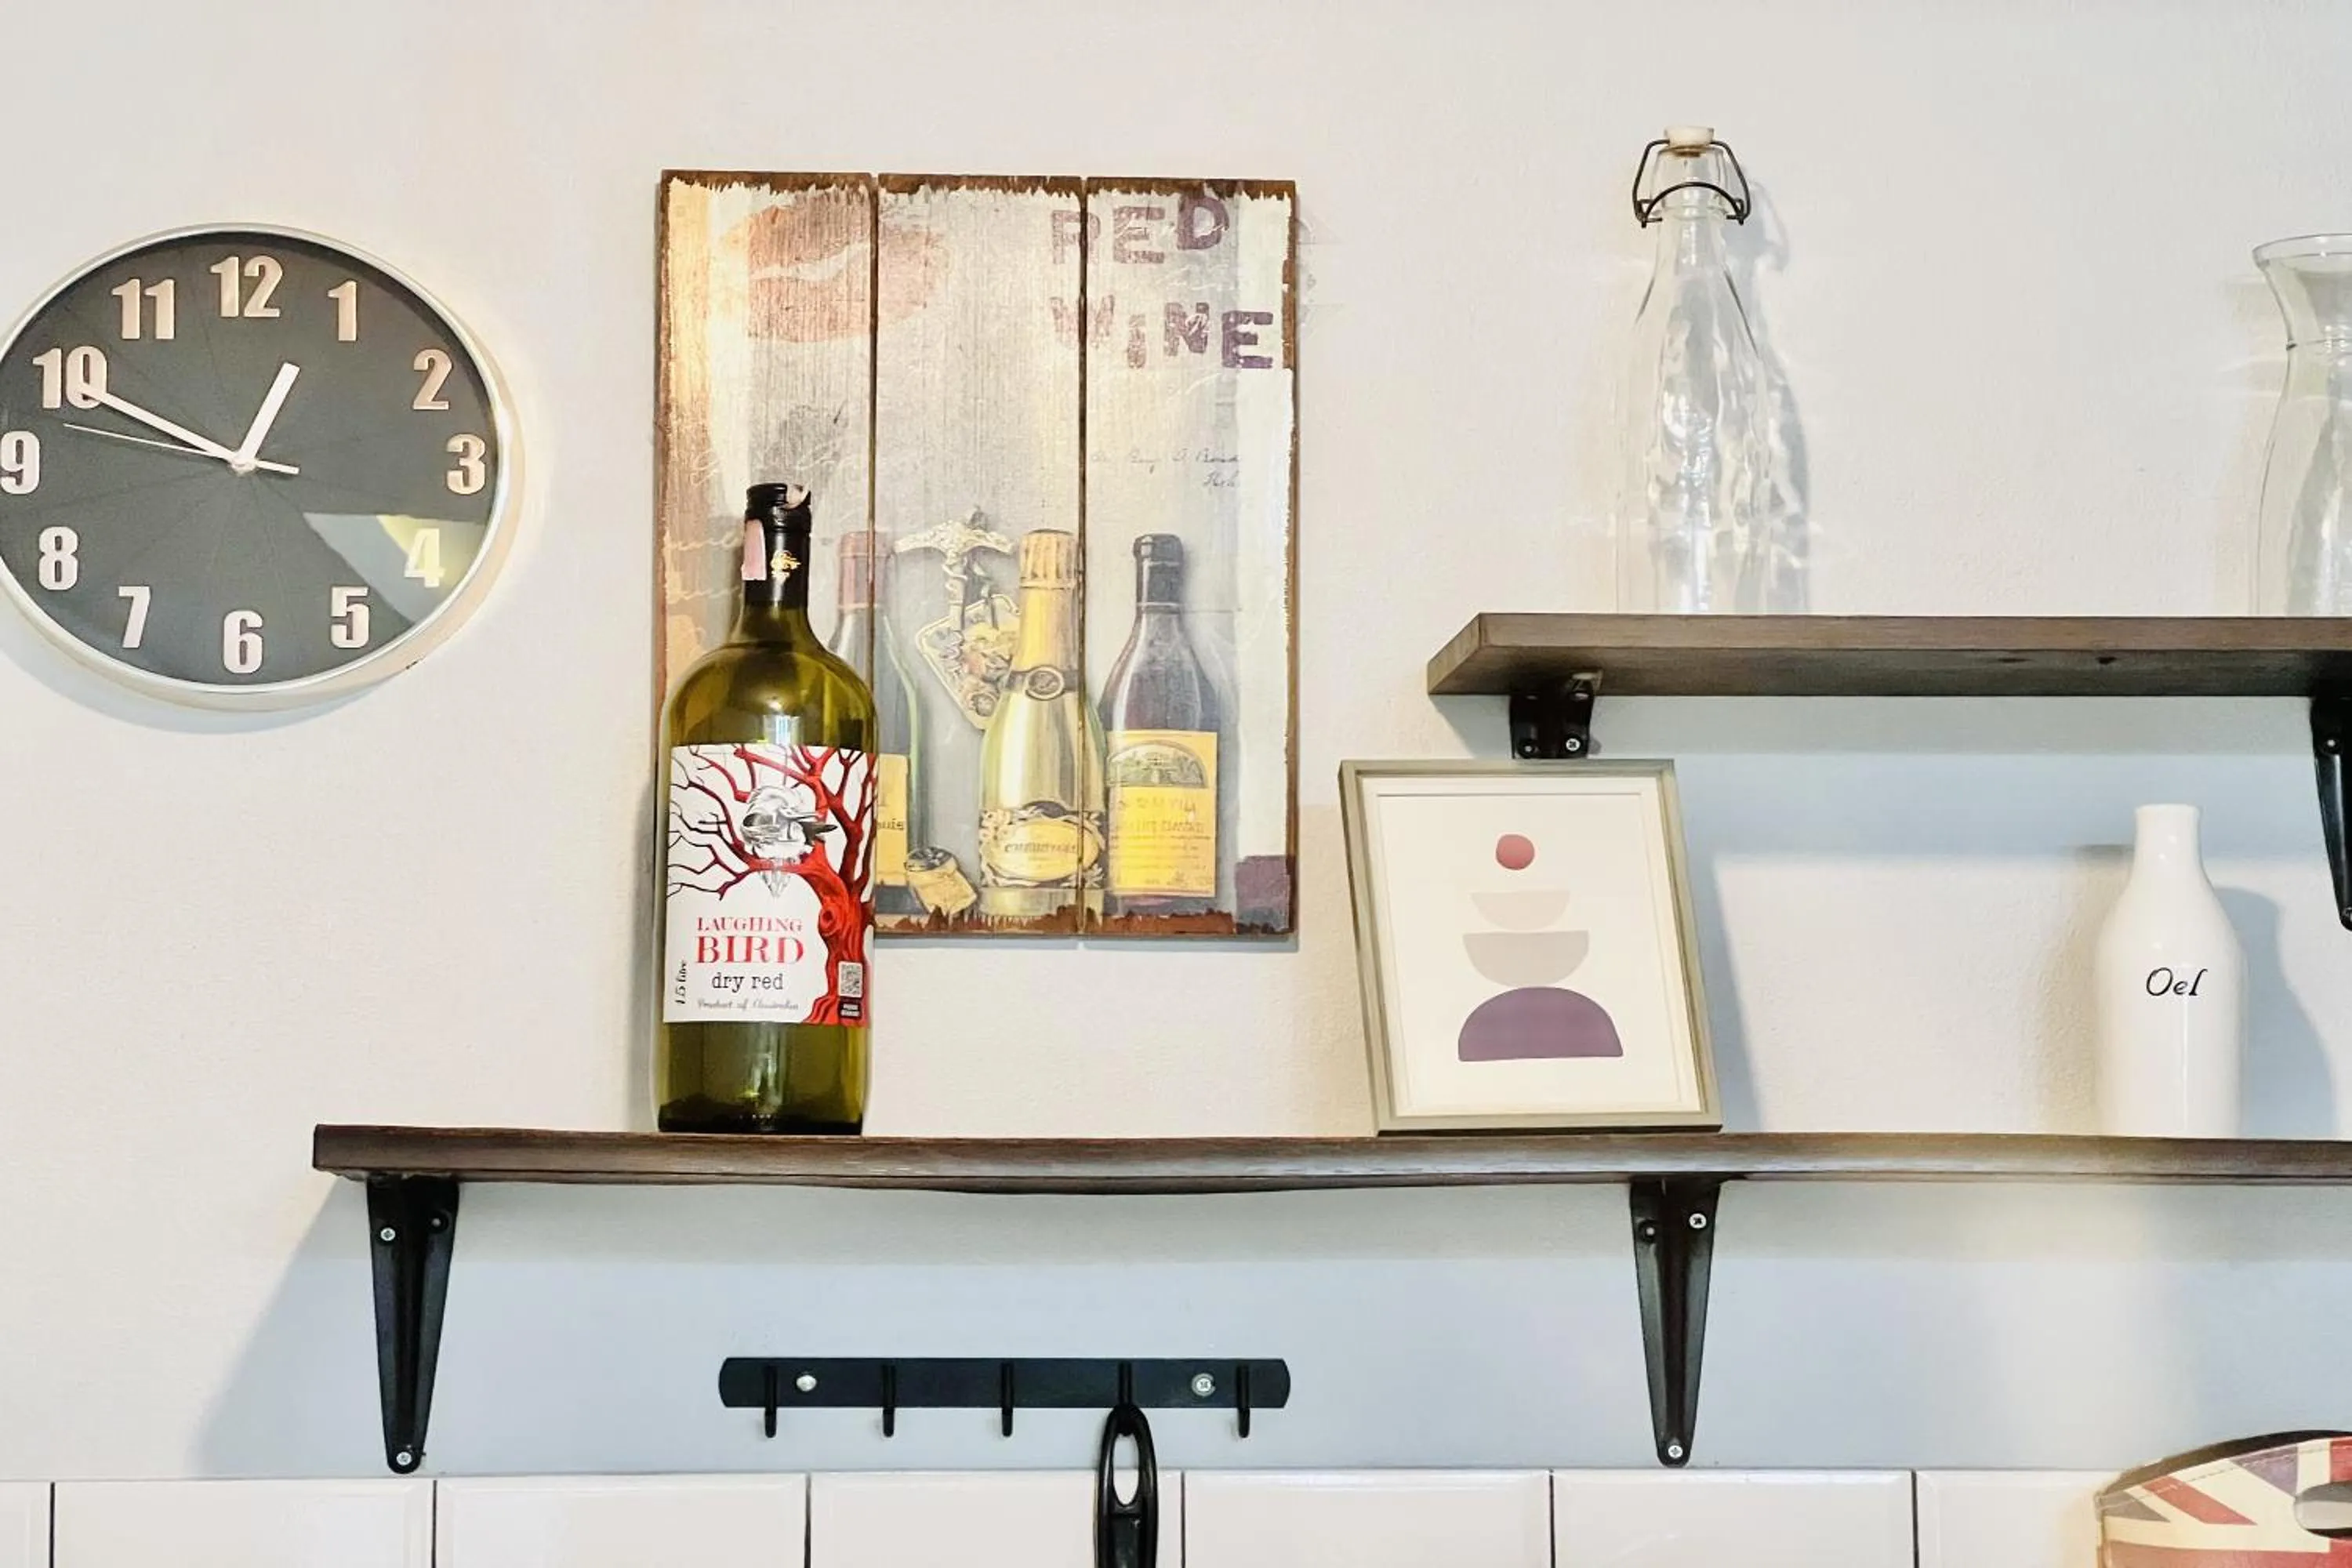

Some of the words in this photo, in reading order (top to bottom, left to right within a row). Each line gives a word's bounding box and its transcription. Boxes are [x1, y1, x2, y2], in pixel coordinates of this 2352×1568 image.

[1051, 194, 1230, 264] RED
[111, 278, 176, 339] 11
[210, 255, 284, 318] 12
[327, 280, 358, 342] 1
[1049, 295, 1274, 369] WINE
[32, 346, 108, 409] 10
[412, 349, 453, 410] 2
[0, 430, 40, 495] 9
[446, 434, 486, 495] 3
[38, 526, 78, 590] 8
[404, 528, 445, 588] 4
[118, 586, 151, 648] 7
[223, 610, 263, 674] 6
[330, 586, 370, 648] 5
[695, 935, 804, 964] BIRD
[696, 916, 803, 932] LAUGHING
[711, 972, 745, 993] dry
[751, 973, 784, 990] red
[2146, 967, 2209, 996] Oel
